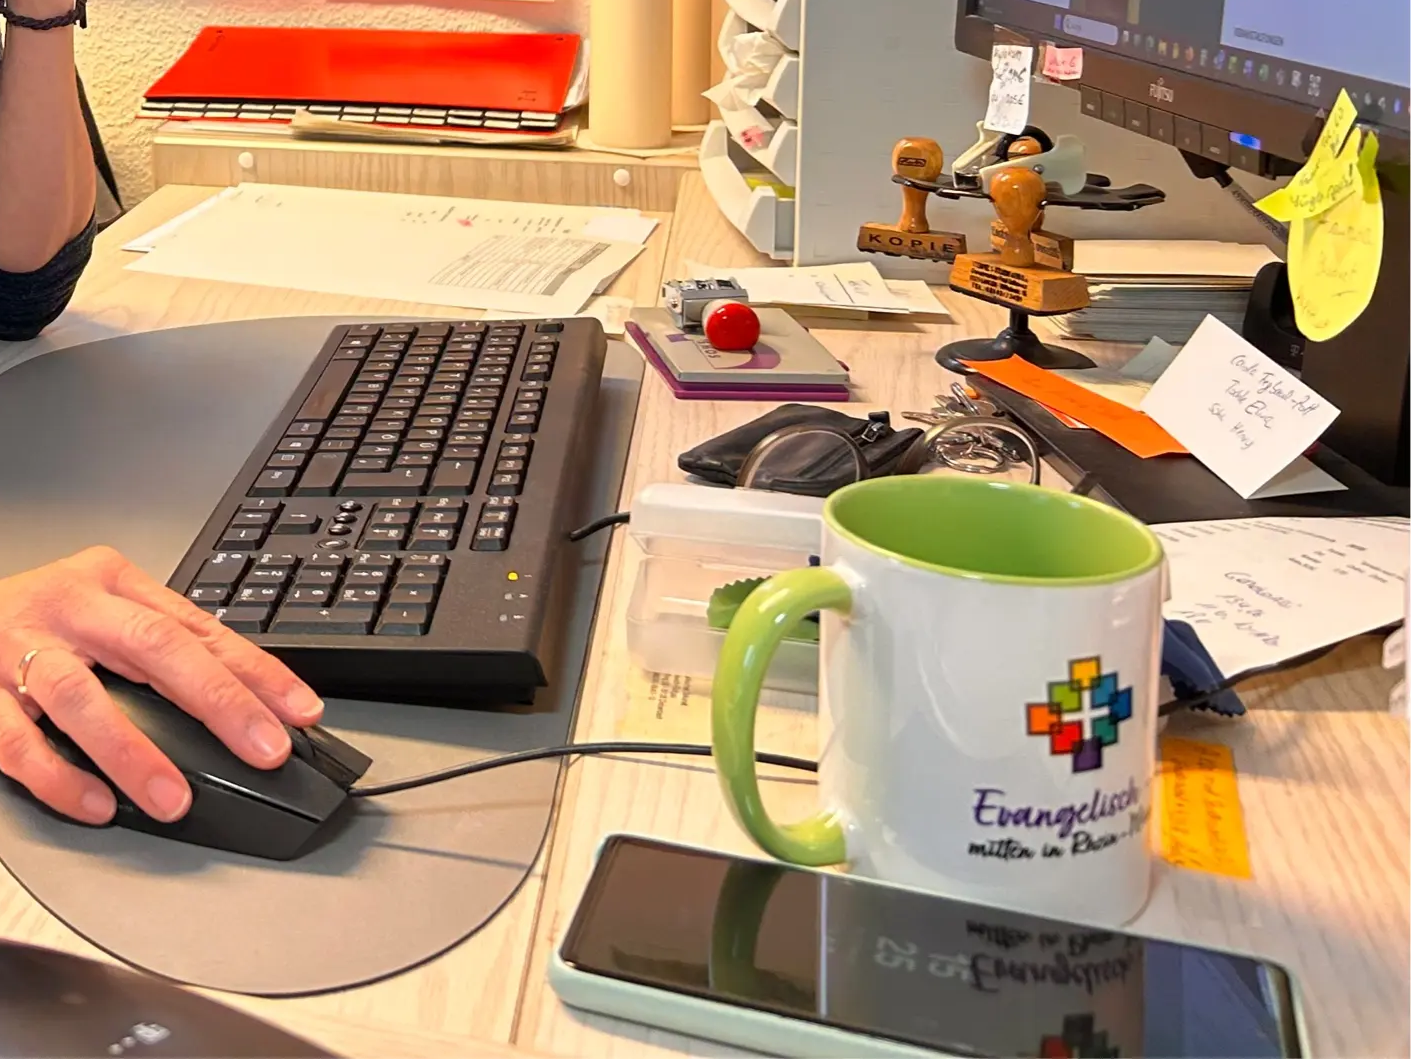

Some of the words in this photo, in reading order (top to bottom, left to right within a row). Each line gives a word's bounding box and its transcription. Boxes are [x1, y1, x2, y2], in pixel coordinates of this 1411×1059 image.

[1149, 83, 1174, 102] FUJITSU
[869, 233, 956, 253] KOPIE
[973, 776, 1139, 839] Evangelisch
[968, 837, 1036, 861] mitten
[1041, 842, 1065, 859] in
